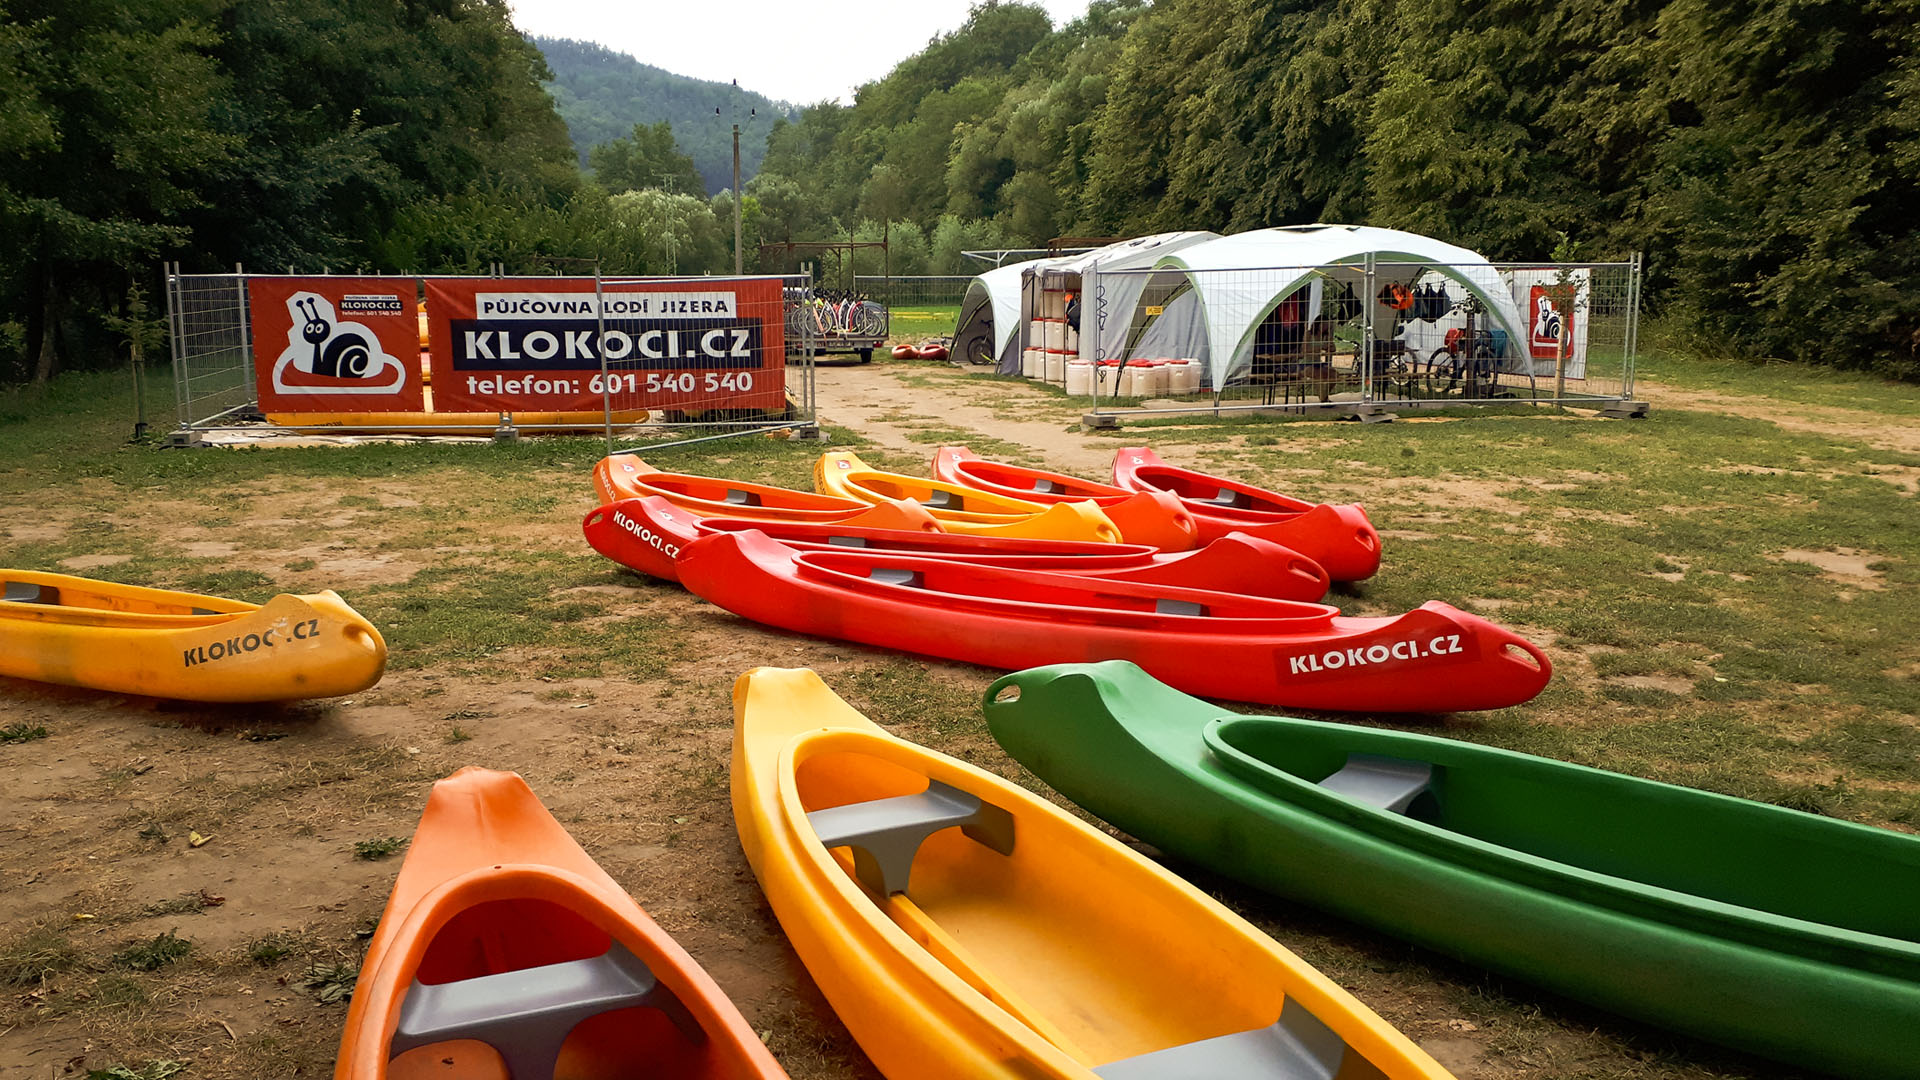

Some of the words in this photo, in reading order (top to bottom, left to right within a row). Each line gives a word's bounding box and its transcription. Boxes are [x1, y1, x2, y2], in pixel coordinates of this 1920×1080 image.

[341, 301, 401, 309] KLOKOCI.CZ
[484, 298, 593, 314] PŮJČOVNA
[603, 298, 649, 314] LODÍ
[660, 299, 729, 313] JIZERA
[464, 329, 751, 360] KLOKOCI.CZ
[466, 374, 579, 395] telefon:
[588, 373, 636, 394] 601
[646, 372, 696, 393] 540
[704, 371, 753, 392] 540
[613, 510, 680, 559] KLOKOCI.CZ
[184, 619, 320, 667] KLOKOC.CZ
[1289, 634, 1463, 675] KLOKOCI.CZ
